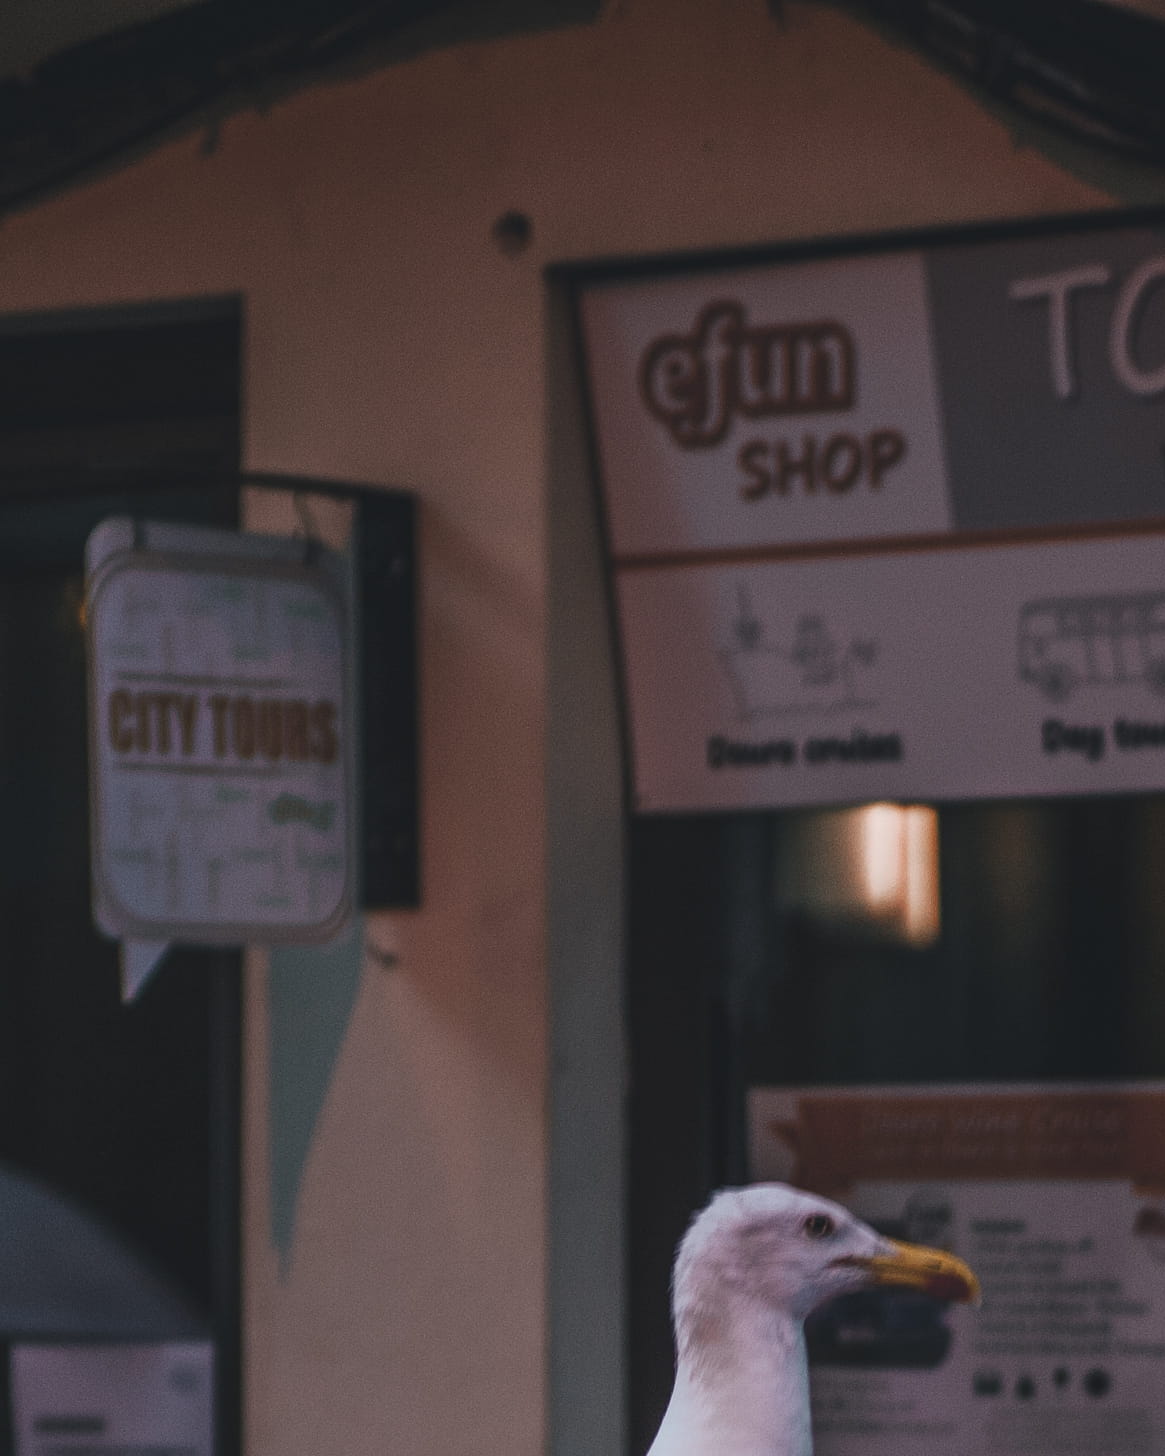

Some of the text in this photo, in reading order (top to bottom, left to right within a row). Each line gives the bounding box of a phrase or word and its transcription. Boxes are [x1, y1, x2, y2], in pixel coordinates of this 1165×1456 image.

[637, 297, 857, 452] efun
[739, 431, 908, 501] SHOP
[109, 689, 339, 766] CITY TOURS
[1042, 719, 1104, 763] Day
